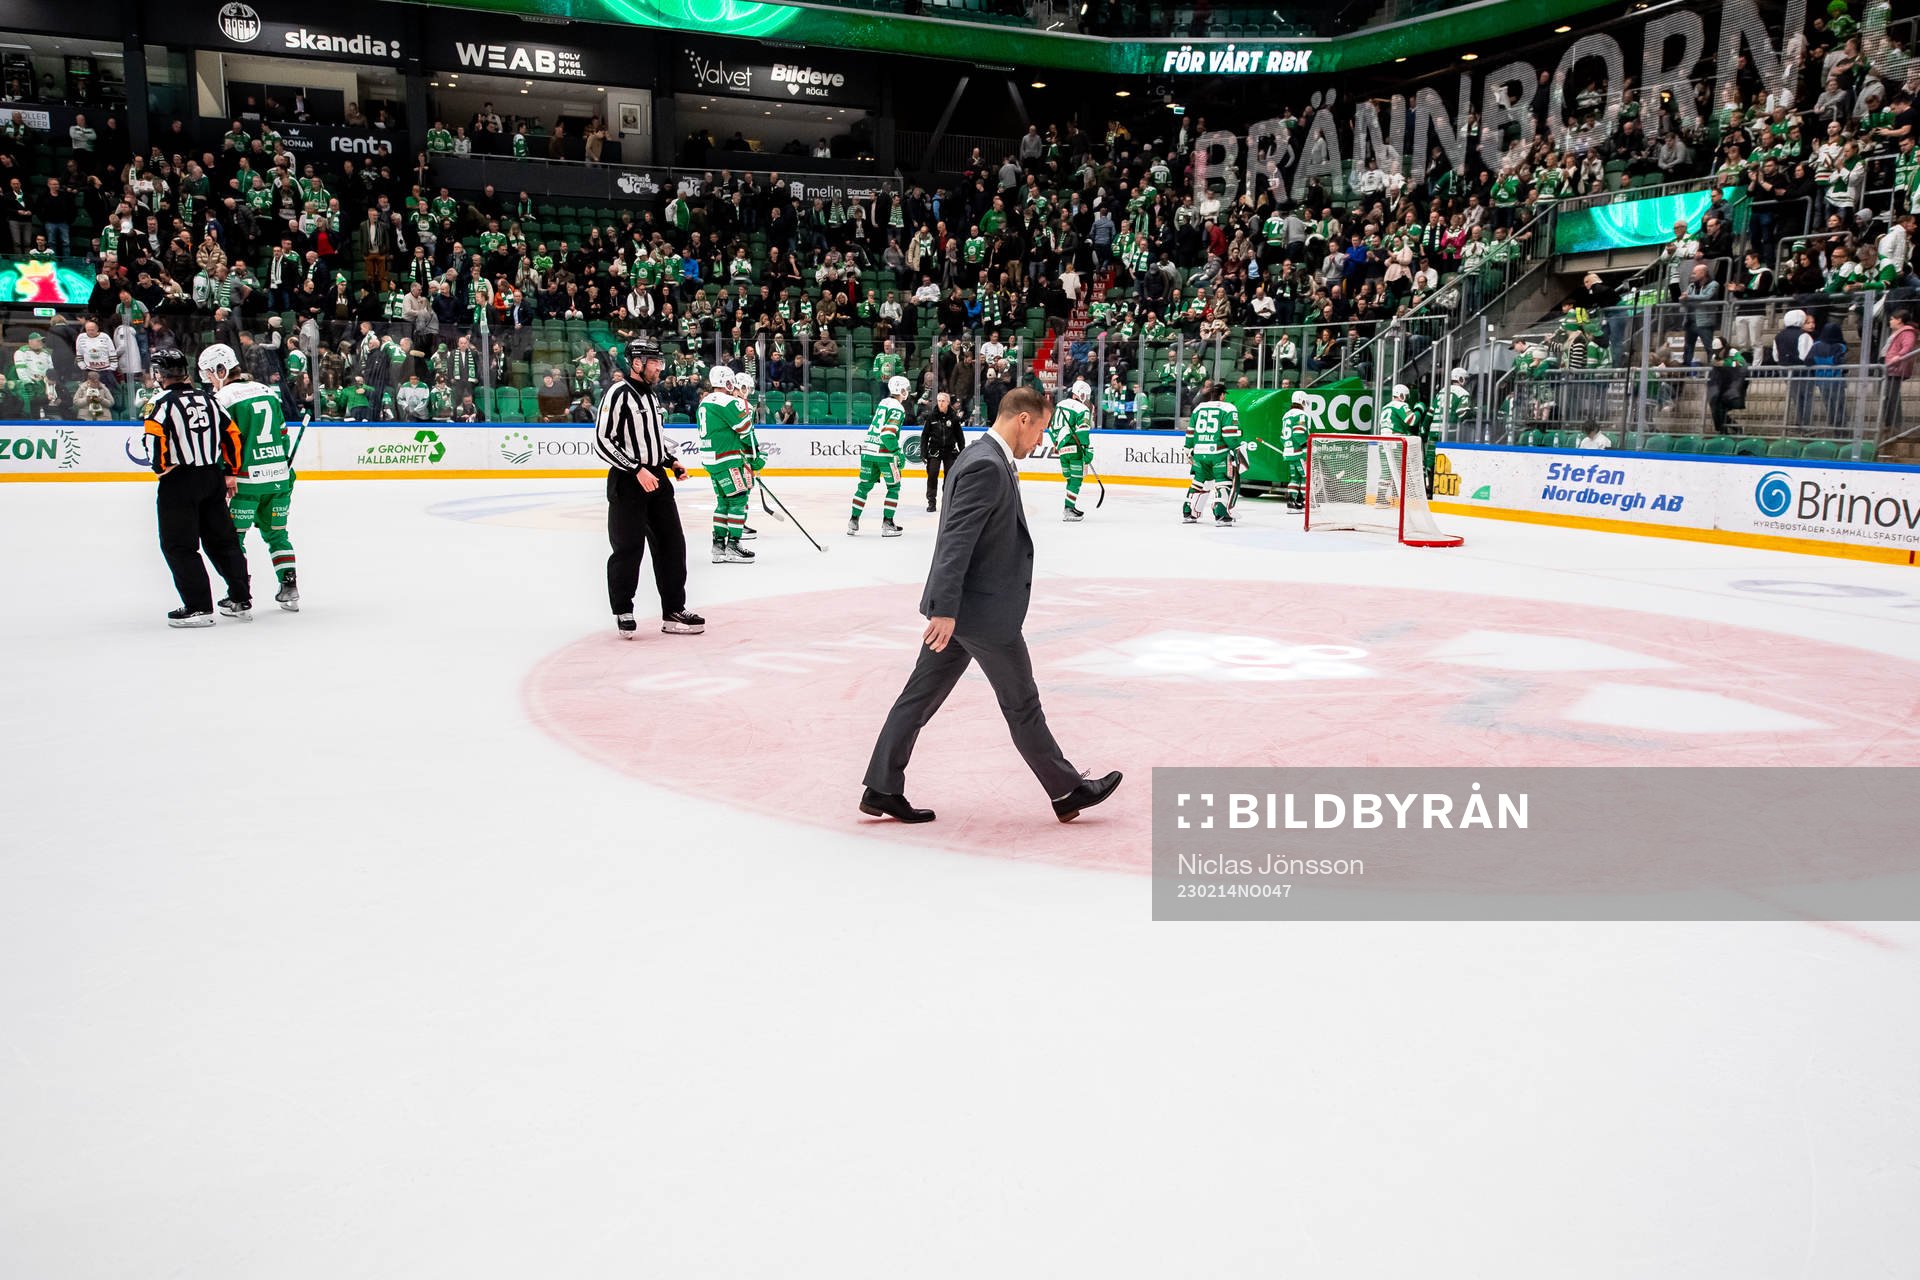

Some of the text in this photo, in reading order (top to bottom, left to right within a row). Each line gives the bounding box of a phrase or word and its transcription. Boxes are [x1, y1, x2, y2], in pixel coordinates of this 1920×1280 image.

[224, 17, 256, 40] RÖGLE
[456, 42, 556, 74] WEAB
[559, 52, 580, 60] GOLV
[559, 60, 580, 68] BYGG
[1163, 44, 1312, 72] FÖR VÅRT RBK
[559, 68, 586, 77] KAKEL
[695, 59, 752, 87] Valvet
[771, 64, 844, 87] Bildeve
[806, 87, 829, 96] RÖGLE
[807, 186, 842, 198] melin
[187, 406, 210, 429] 25
[251, 400, 274, 444] 7
[891, 410, 901, 420] 23
[1196, 409, 1220, 433] 65
[1125, 447, 1188, 464] Backahi
[1546, 462, 1625, 486] Stefan
[1542, 485, 1684, 512] Nordbergh AB
[1797, 480, 1920, 530] Brinov
